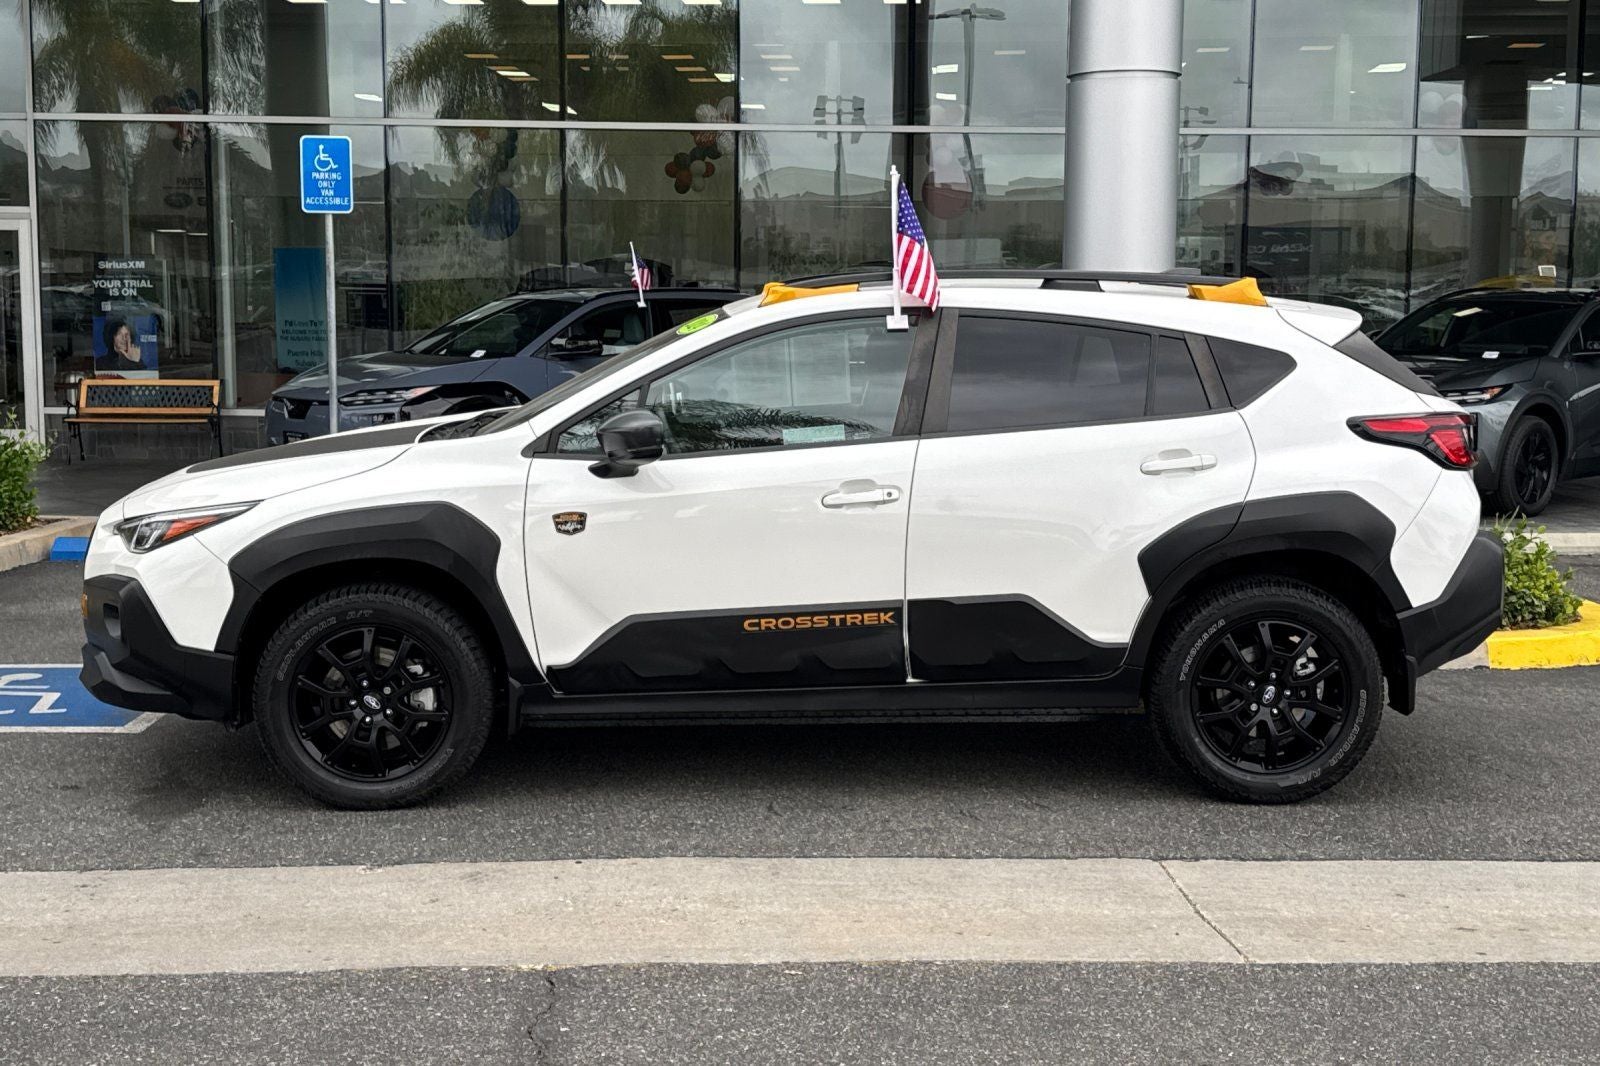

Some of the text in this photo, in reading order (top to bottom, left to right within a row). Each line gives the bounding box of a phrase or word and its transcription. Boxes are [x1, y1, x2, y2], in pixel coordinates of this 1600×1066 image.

[311, 172, 342, 180] PARKING
[305, 197, 350, 205] ACCESSIBLE
[98, 260, 145, 269] SiriusXM
[92, 280, 153, 288] YOUR TRIAL
[109, 288, 137, 296] IS ON
[743, 611, 896, 631] CROSSTREK
[1180, 618, 1226, 682] YOKOHAMA
